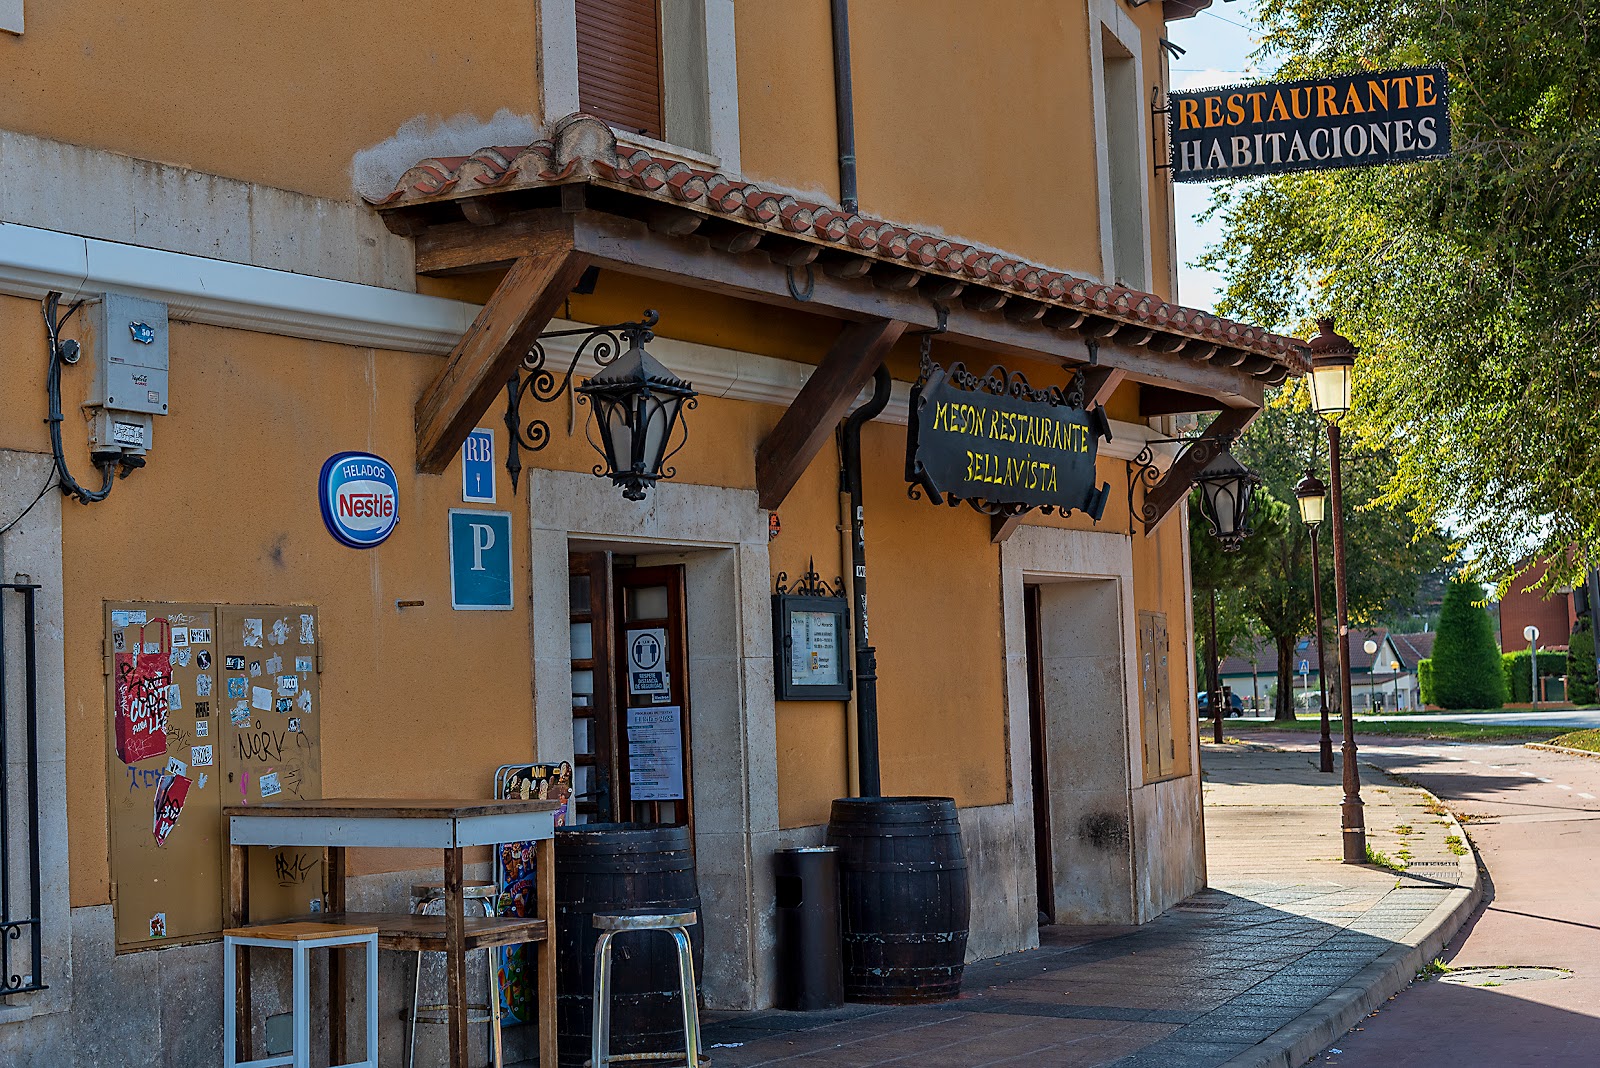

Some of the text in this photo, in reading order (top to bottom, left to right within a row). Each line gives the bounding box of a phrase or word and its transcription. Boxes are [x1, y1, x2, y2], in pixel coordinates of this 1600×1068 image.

[1178, 74, 1438, 131] RESTAURANTE
[1179, 116, 1437, 172] HABITACIONES
[466, 436, 491, 462] RB
[932, 400, 1090, 453] MESON RESTAURANTE
[342, 464, 386, 479] HELADOS
[963, 450, 1059, 492] BELLAVISTA
[339, 493, 393, 518] Nestlé
[468, 523, 496, 571] P
